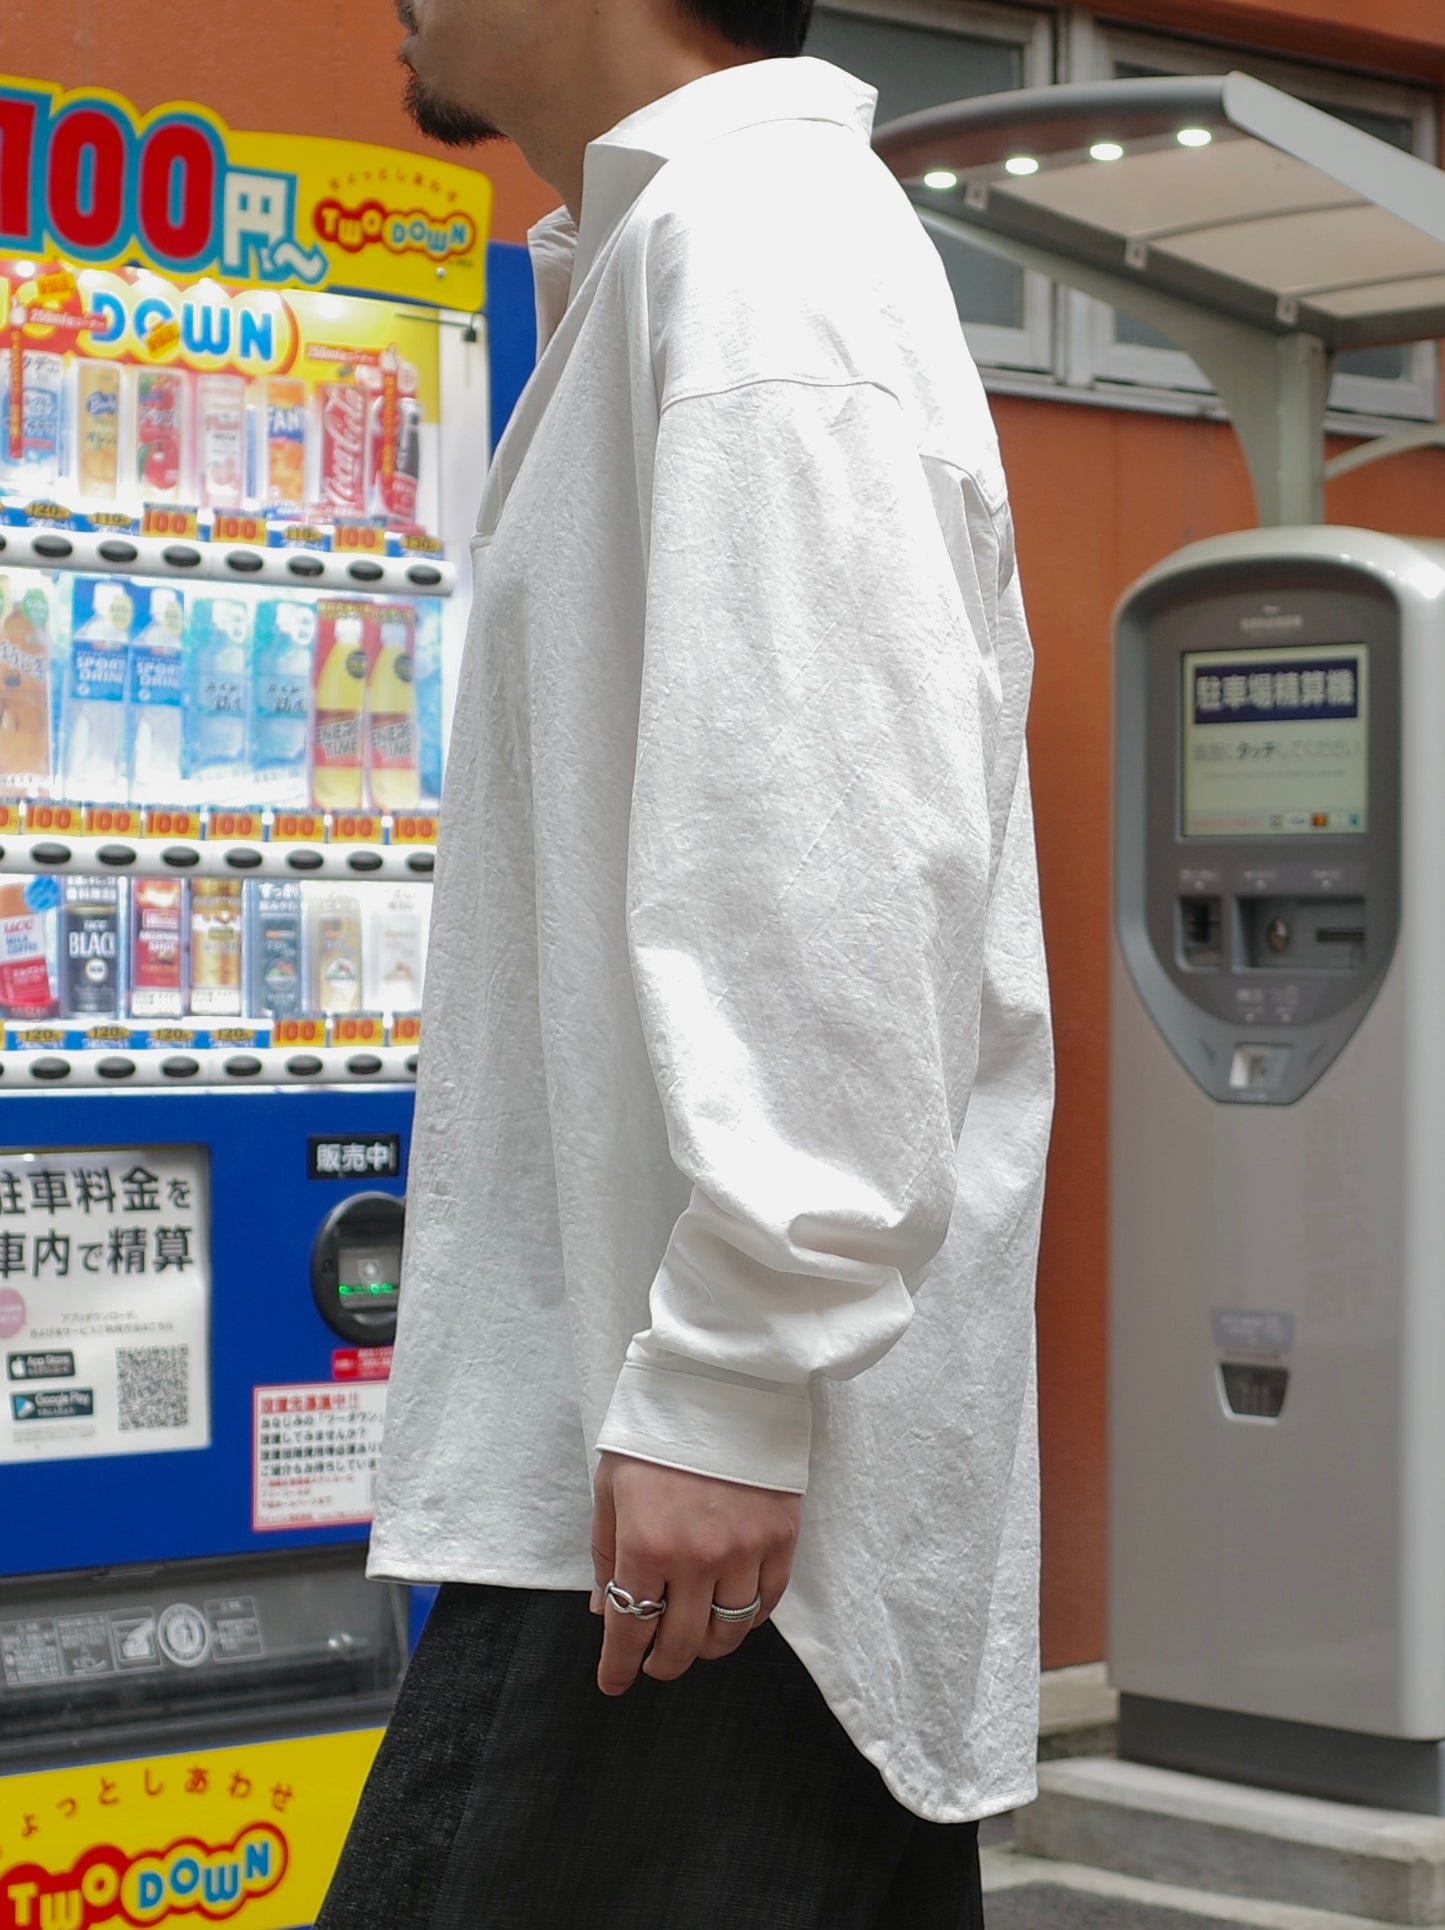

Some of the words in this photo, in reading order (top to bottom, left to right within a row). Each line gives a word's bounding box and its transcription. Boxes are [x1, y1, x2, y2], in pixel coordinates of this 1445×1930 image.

[321, 207, 384, 246] TWO
[391, 219, 466, 253] DOWN
[394, 1019, 421, 1039] 10
[317, 1143, 389, 1172] 販売中
[35, 1393, 69, 1406] Google
[70, 1392, 89, 1407] Play
[21, 1765, 293, 1838] ょっとしあわせ
[7, 1863, 118, 1930] TWO
[138, 1841, 269, 1909] DOWN
